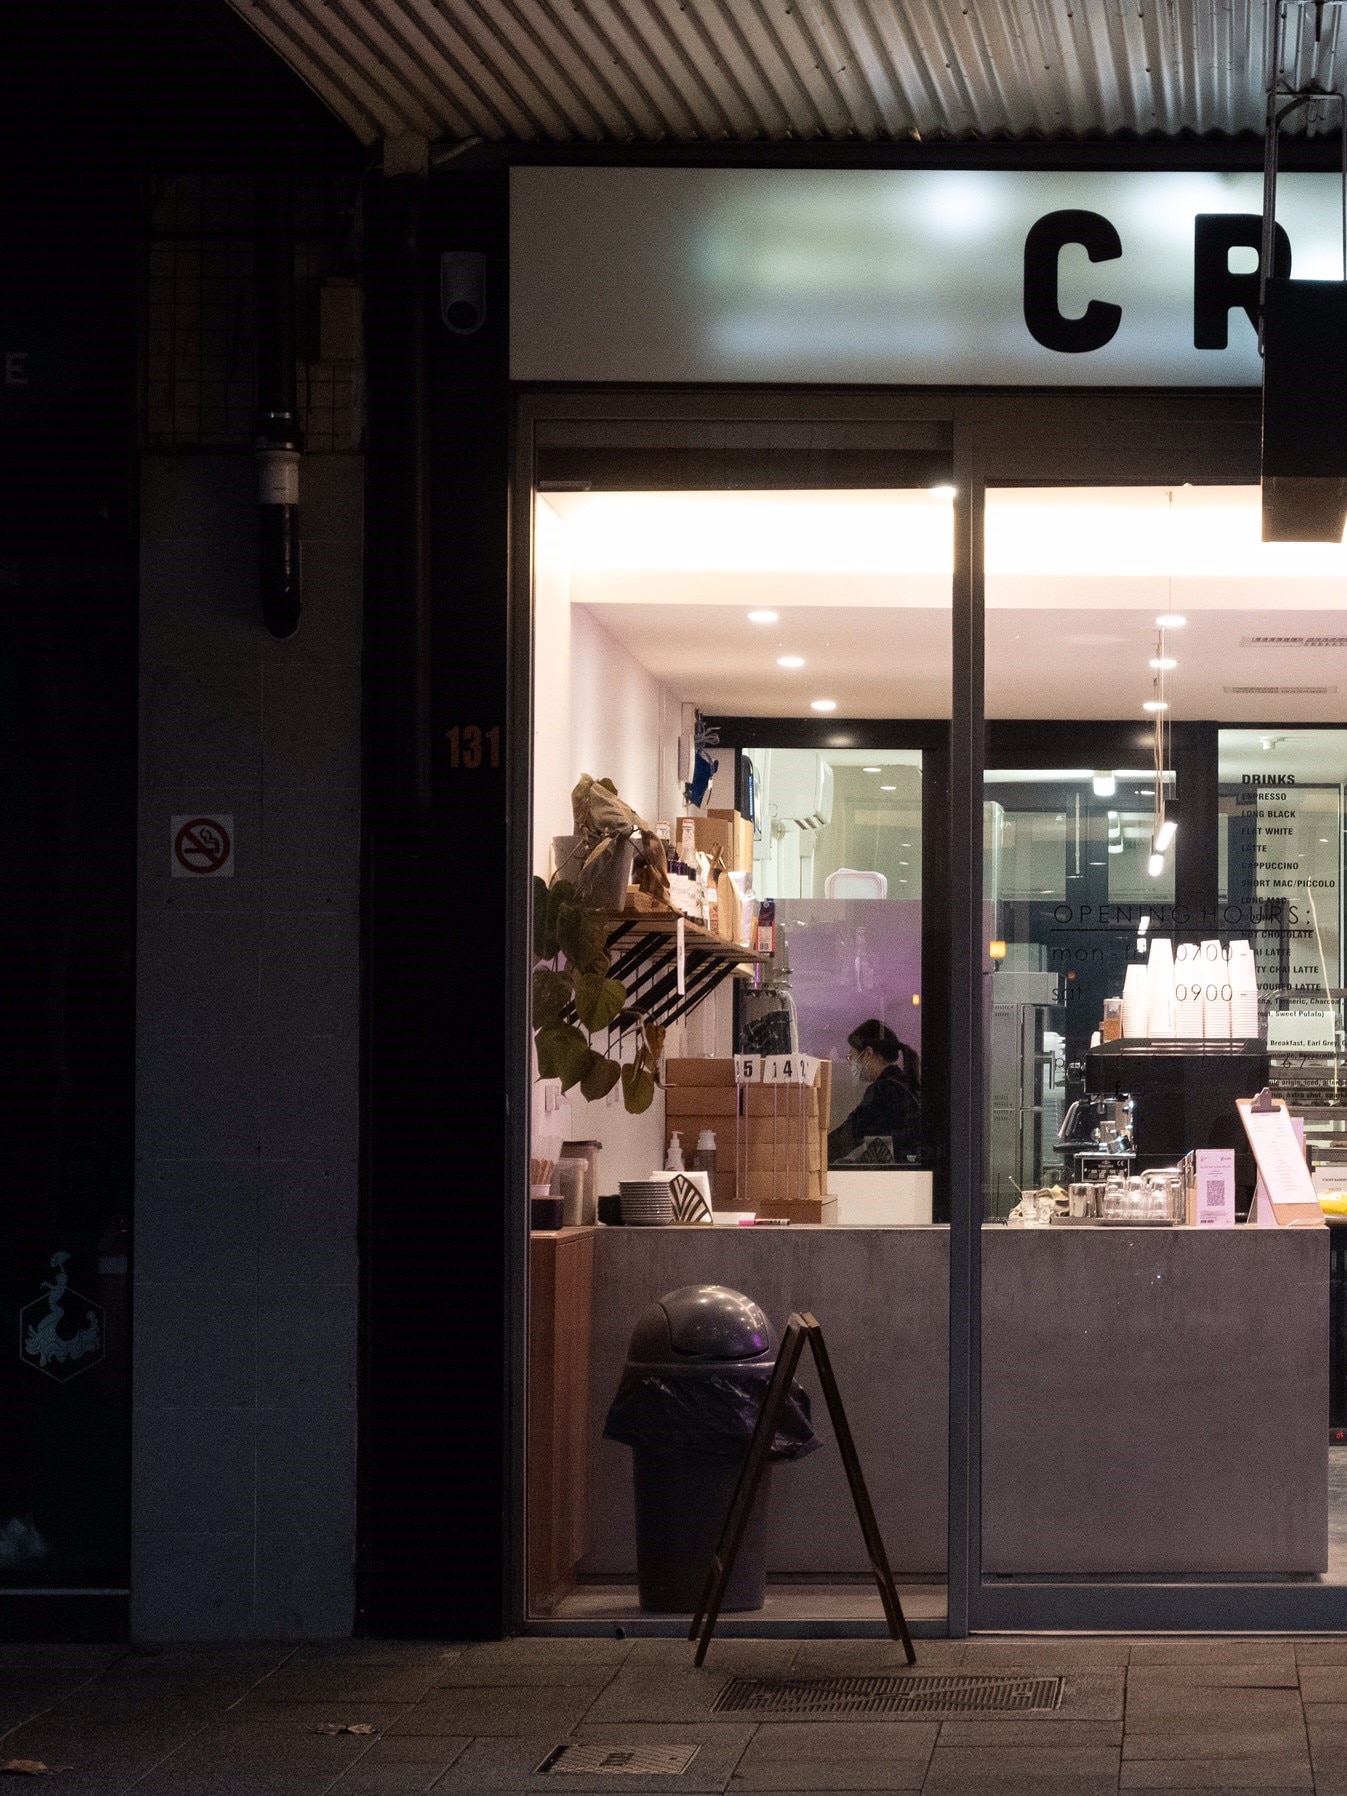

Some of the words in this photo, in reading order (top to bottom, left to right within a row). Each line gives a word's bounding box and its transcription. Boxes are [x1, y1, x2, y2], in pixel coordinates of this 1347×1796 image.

[445, 725, 502, 769] 131
[1241, 774, 1295, 785] DRINKS
[1241, 793, 1287, 801] ESPRESSO
[1241, 810, 1265, 818] LONG
[1267, 810, 1296, 818] BLACK
[1241, 827, 1262, 835] FLAT
[1265, 827, 1294, 835] WHITE
[1241, 844, 1267, 852] LATTE
[1241, 862, 1299, 870] CAPPUCCINO
[1241, 879, 1271, 887] SHORT
[1273, 879, 1335, 888] MAC/PICCOLO
[1241, 897, 1264, 905] LONG
[1266, 897, 1287, 905] MAC
[1053, 904, 1192, 925] OPENING
[1202, 904, 1312, 925] HOURS:
[1261, 930, 1314, 939] CHOCOLATE
[1051, 947, 1104, 962] mon
[1175, 943, 1234, 962] 0700
[1265, 948, 1291, 956] LATTE
[1269, 966, 1290, 974] CHAI
[1293, 966, 1319, 974] LATTE
[1295, 983, 1321, 991] LATTE
[1051, 983, 1082, 1002] sat
[1174, 983, 1234, 1002] 0900
[1298, 1011, 1325, 1019] Potato)
